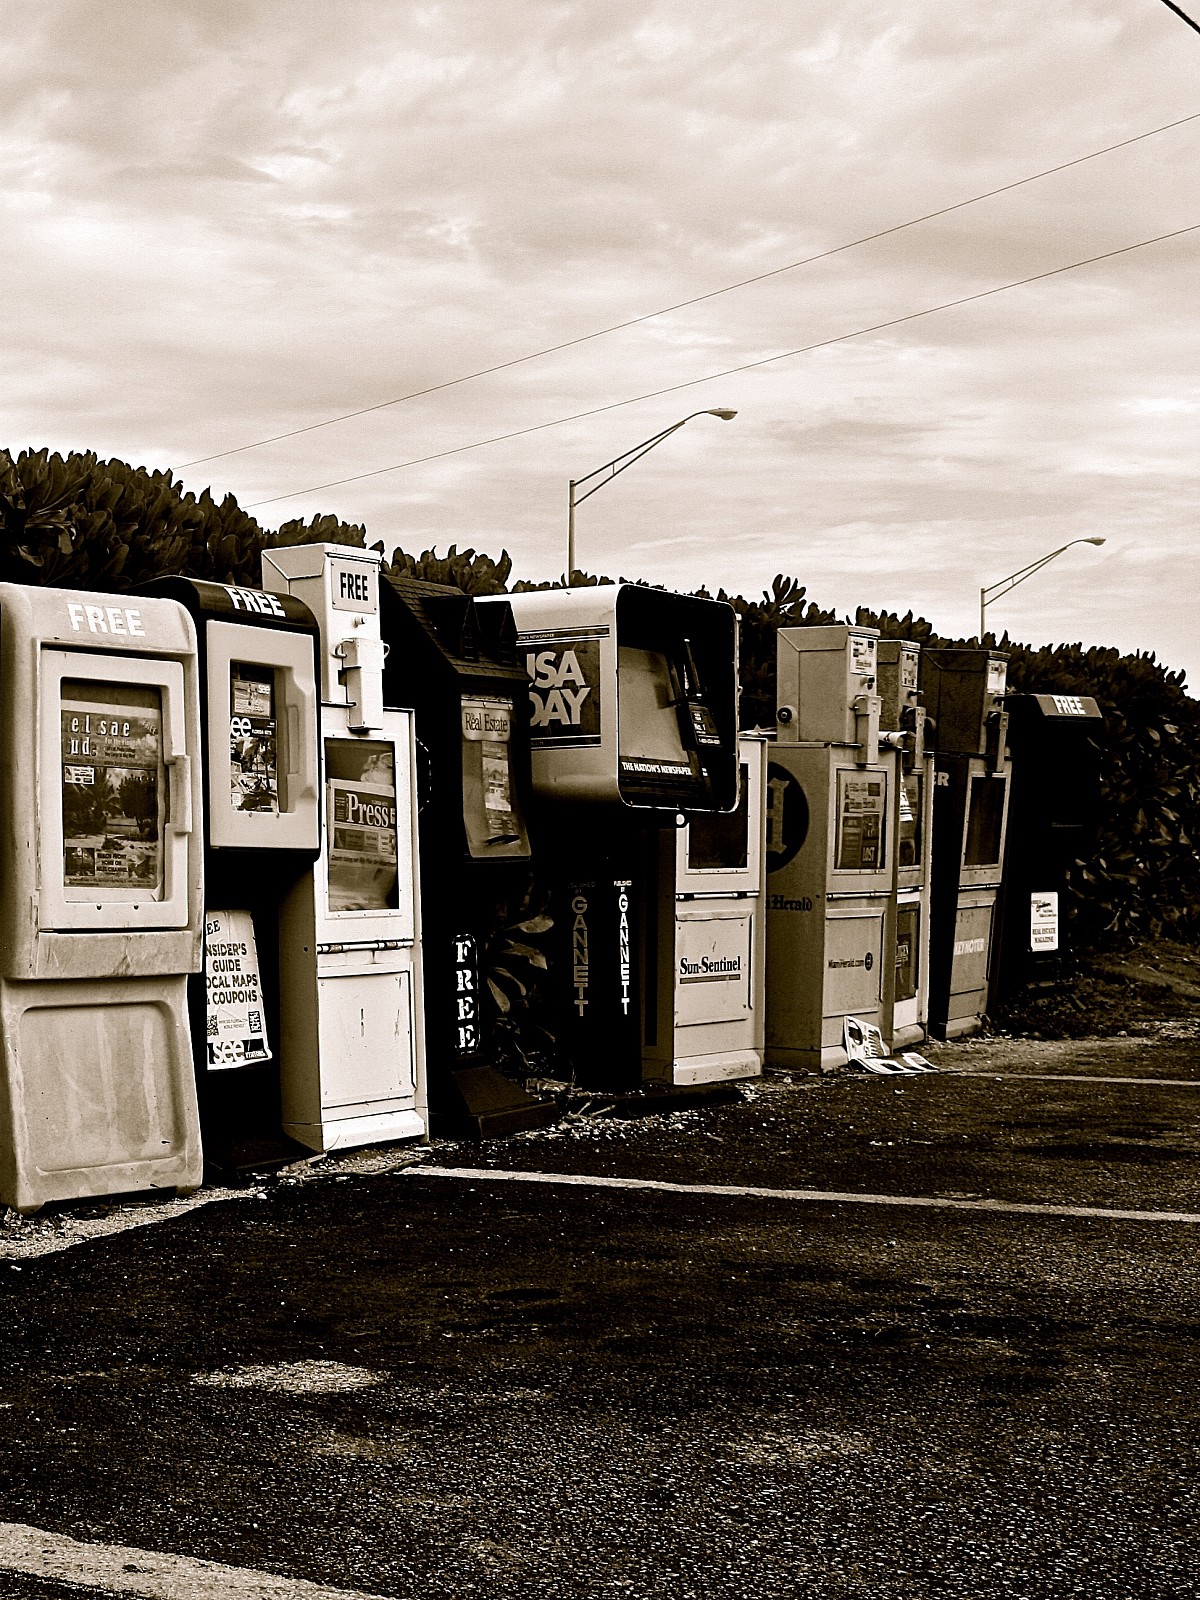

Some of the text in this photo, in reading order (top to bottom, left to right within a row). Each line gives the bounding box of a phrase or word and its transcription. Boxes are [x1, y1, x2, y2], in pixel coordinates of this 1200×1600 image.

[341, 572, 368, 601] FREE
[223, 586, 286, 618] FREE
[66, 603, 146, 637] FREE
[1052, 695, 1087, 714] FREE
[465, 713, 508, 732] Real Estate
[621, 762, 693, 776] THE NATION'S NEWSPAPER
[346, 793, 389, 828] Press
[771, 894, 813, 912] Herald
[206, 920, 221, 936] EE
[571, 896, 589, 1017] GANNETT
[619, 894, 630, 1016] GANNETT
[212, 958, 241, 972] GUIDE
[679, 956, 741, 975] Sun-Sentinel
[232, 974, 258, 987] MAPS
[212, 990, 258, 1005] COUPONS
[455, 940, 476, 1049] FREE
